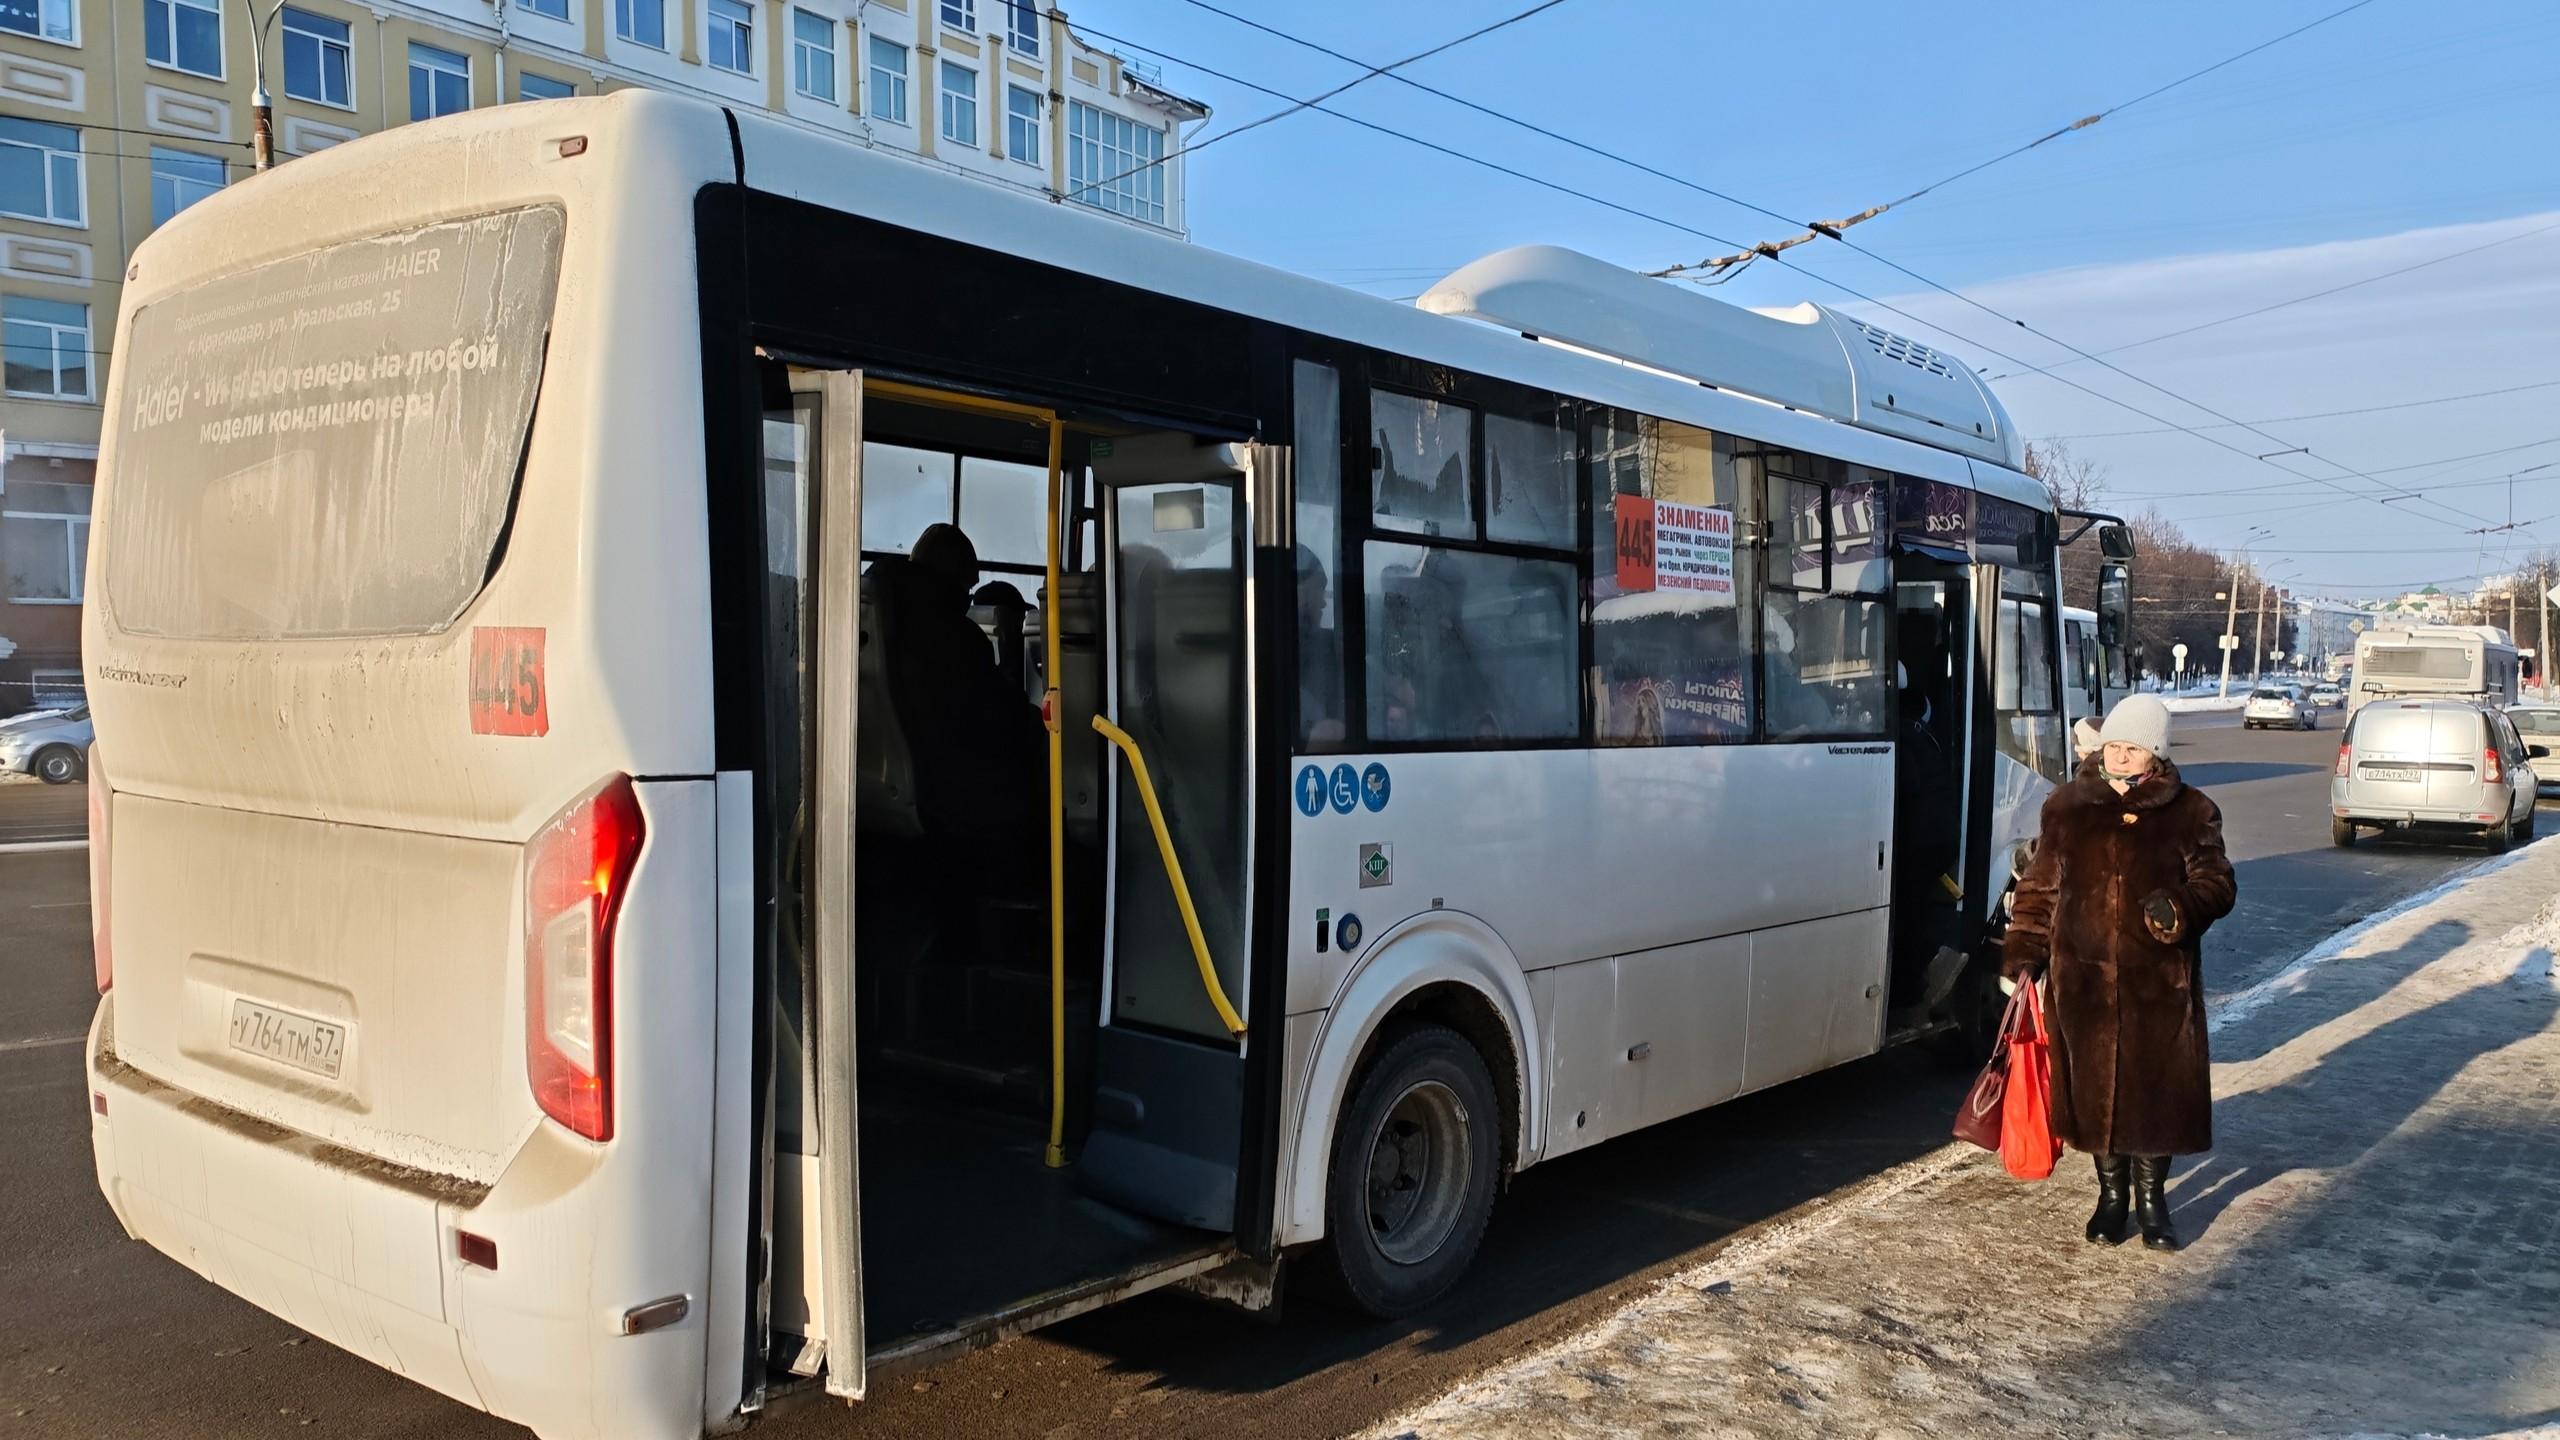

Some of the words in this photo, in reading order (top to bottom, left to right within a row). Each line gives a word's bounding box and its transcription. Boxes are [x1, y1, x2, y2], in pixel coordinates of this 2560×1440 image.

[257, 281, 330, 305] климатический
[335, 271, 379, 289] магазин
[382, 248, 440, 281] HAIER
[199, 322, 264, 354] Краснодар,
[267, 316, 287, 340] ул.
[292, 299, 376, 333] Уральская,
[380, 289, 401, 313] 25
[291, 359, 366, 391] теперь
[371, 352, 401, 379] на
[405, 335, 498, 376] любой
[200, 413, 264, 444] модели
[269, 391, 434, 433] кондиционера
[1619, 516, 1653, 568] 445
[1657, 505, 1730, 535] ЗНАМЕНКА
[1657, 529, 1693, 545] МЕГАГРИНН,
[1694, 534, 1731, 550] АВТОВОКЗАЛ
[1657, 574, 1692, 589] МЕЗЕНСКИЙ
[475, 647, 539, 717] 445
[310, 1055, 325, 1070] RUS
[312, 1026, 335, 1058] 57
